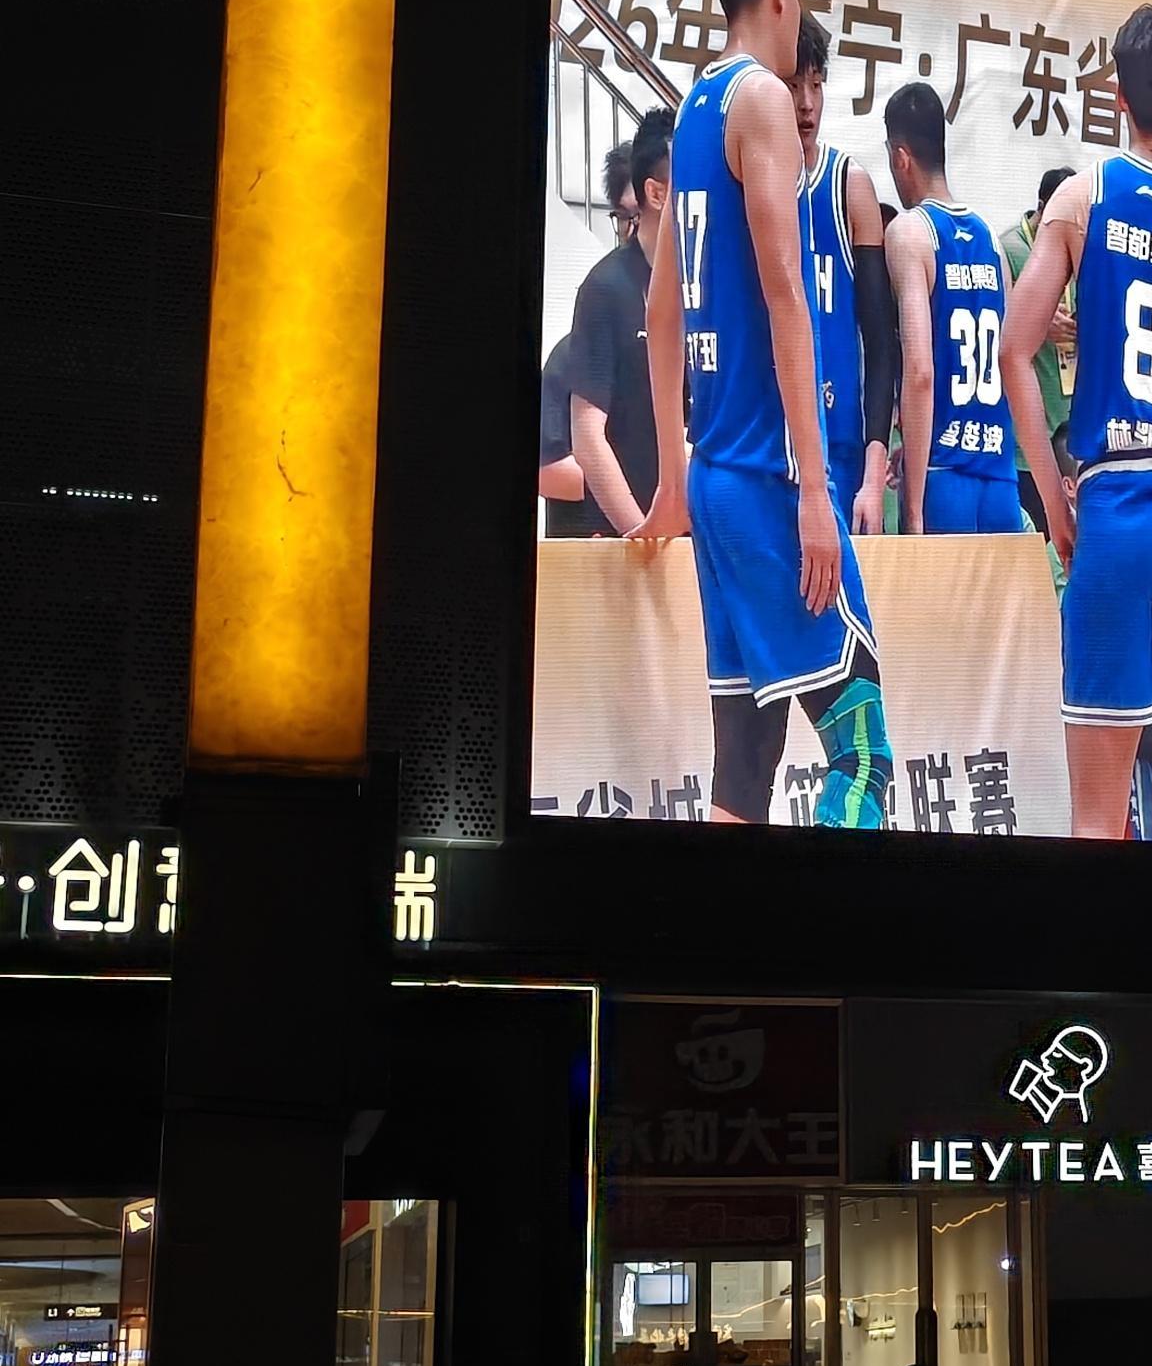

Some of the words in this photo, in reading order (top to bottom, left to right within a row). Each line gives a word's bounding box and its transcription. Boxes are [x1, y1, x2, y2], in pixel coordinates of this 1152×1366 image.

[949, 307, 1002, 407] 30
[602, 1105, 838, 1166] 永和大王
[910, 1139, 1125, 1182] HEYTEA
